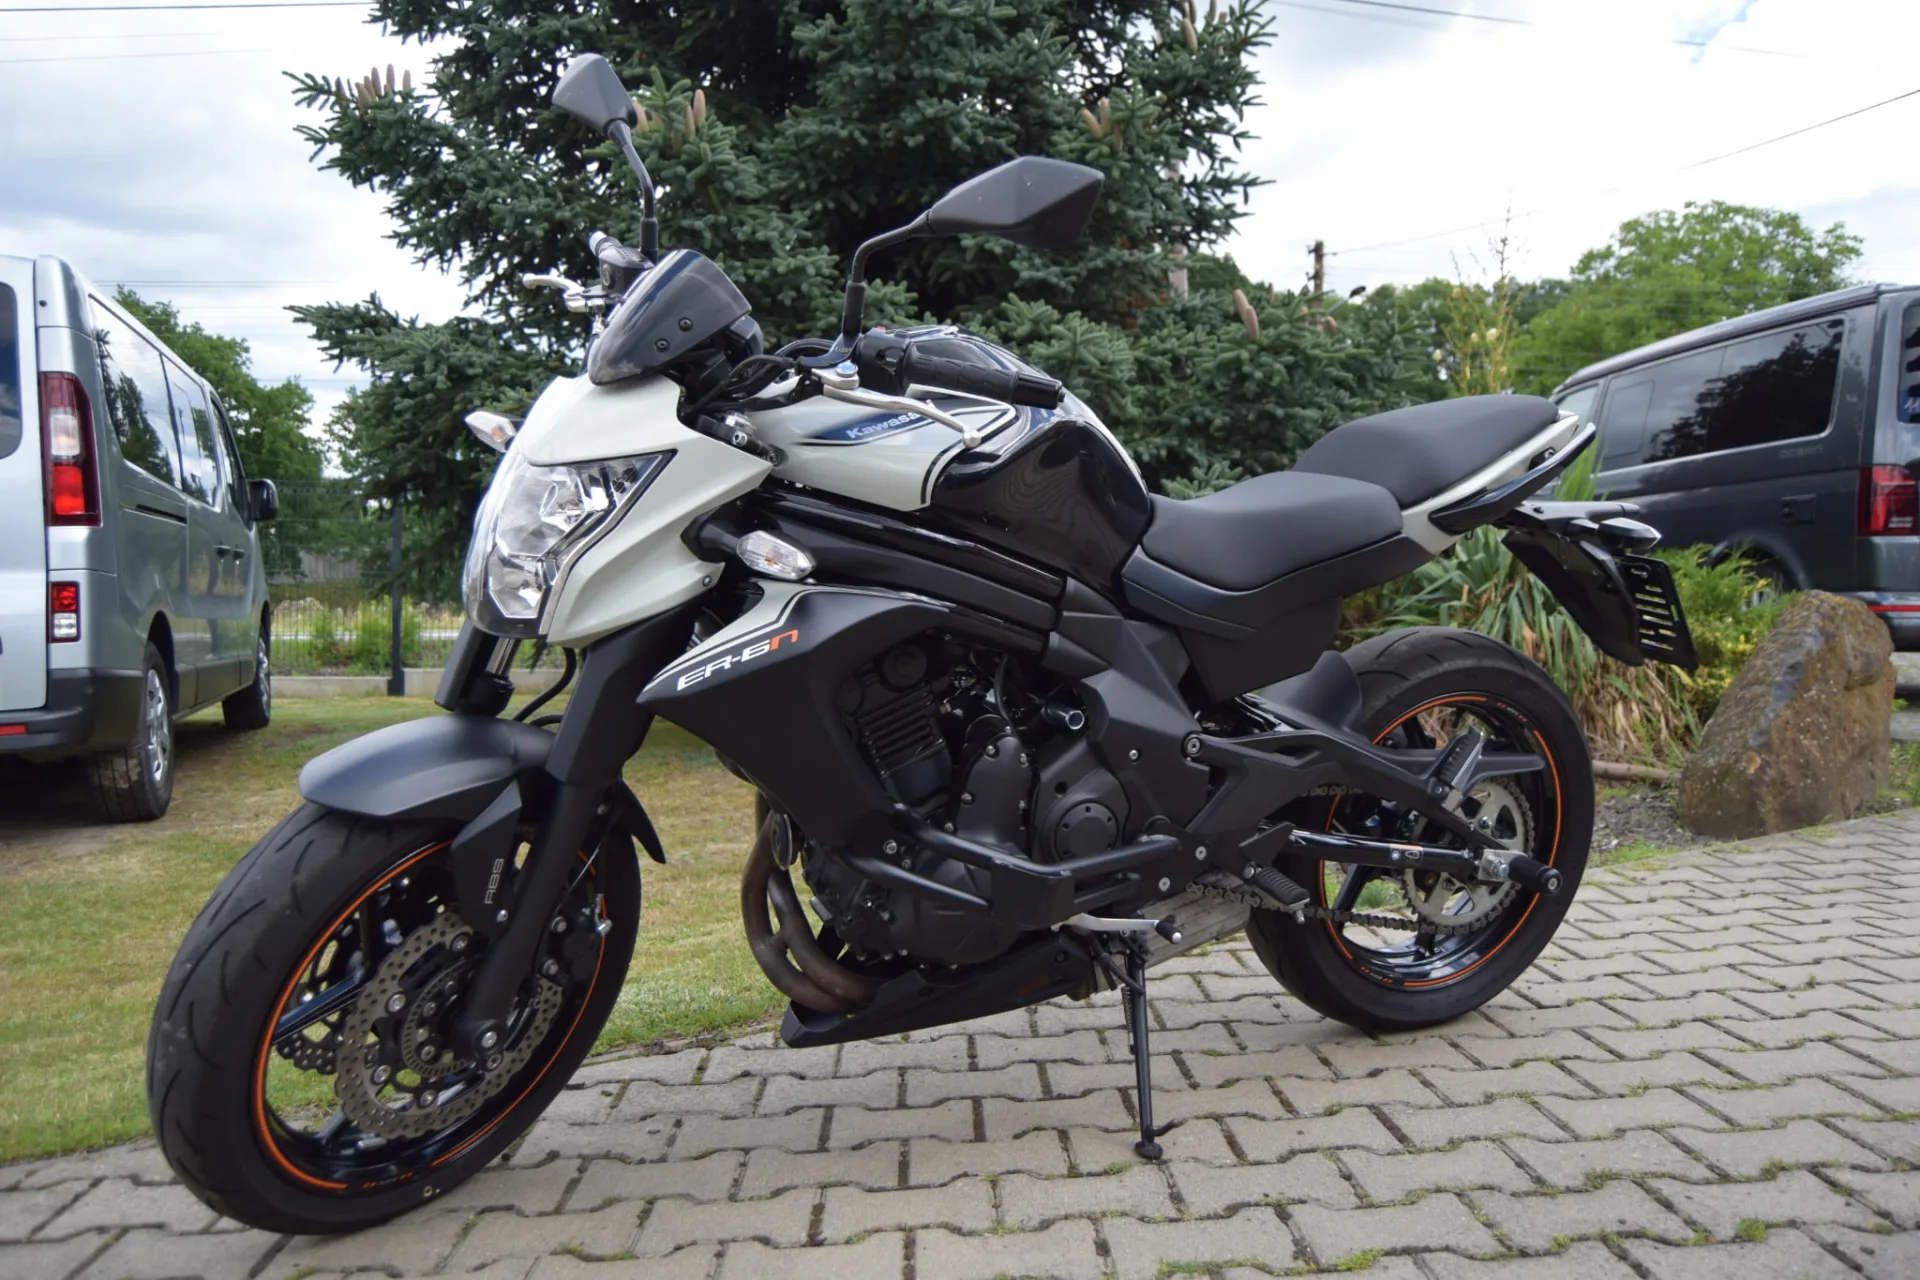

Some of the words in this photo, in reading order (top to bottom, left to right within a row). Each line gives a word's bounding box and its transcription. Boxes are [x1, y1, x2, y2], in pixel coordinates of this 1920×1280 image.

[846, 405, 931, 439] Kawasa
[677, 629, 799, 691] ER-6n
[484, 858, 504, 904] ABS
